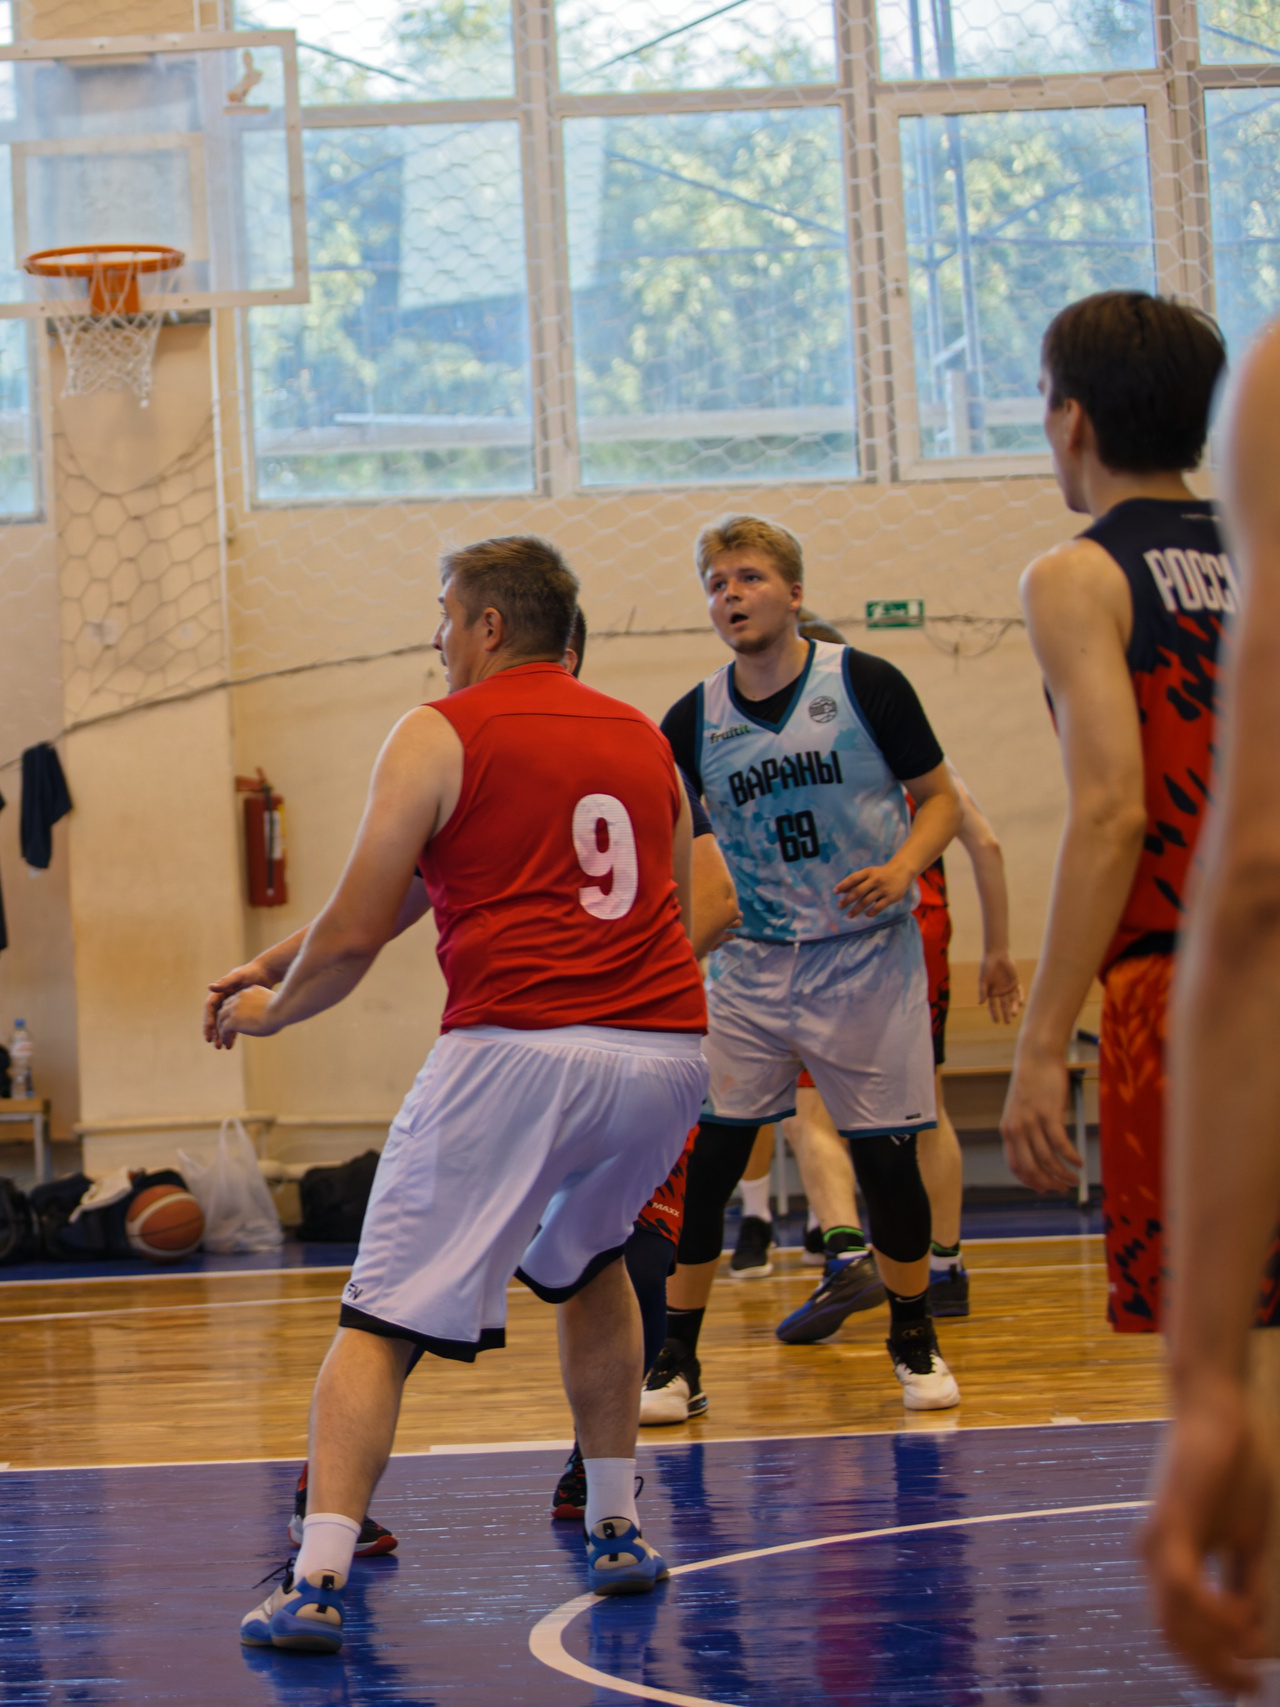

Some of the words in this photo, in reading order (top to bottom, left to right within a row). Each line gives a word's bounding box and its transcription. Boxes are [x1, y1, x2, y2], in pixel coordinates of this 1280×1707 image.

[728, 751, 843, 807] ВАРАНЫ
[572, 793, 638, 920] 9
[775, 810, 819, 862] 69
